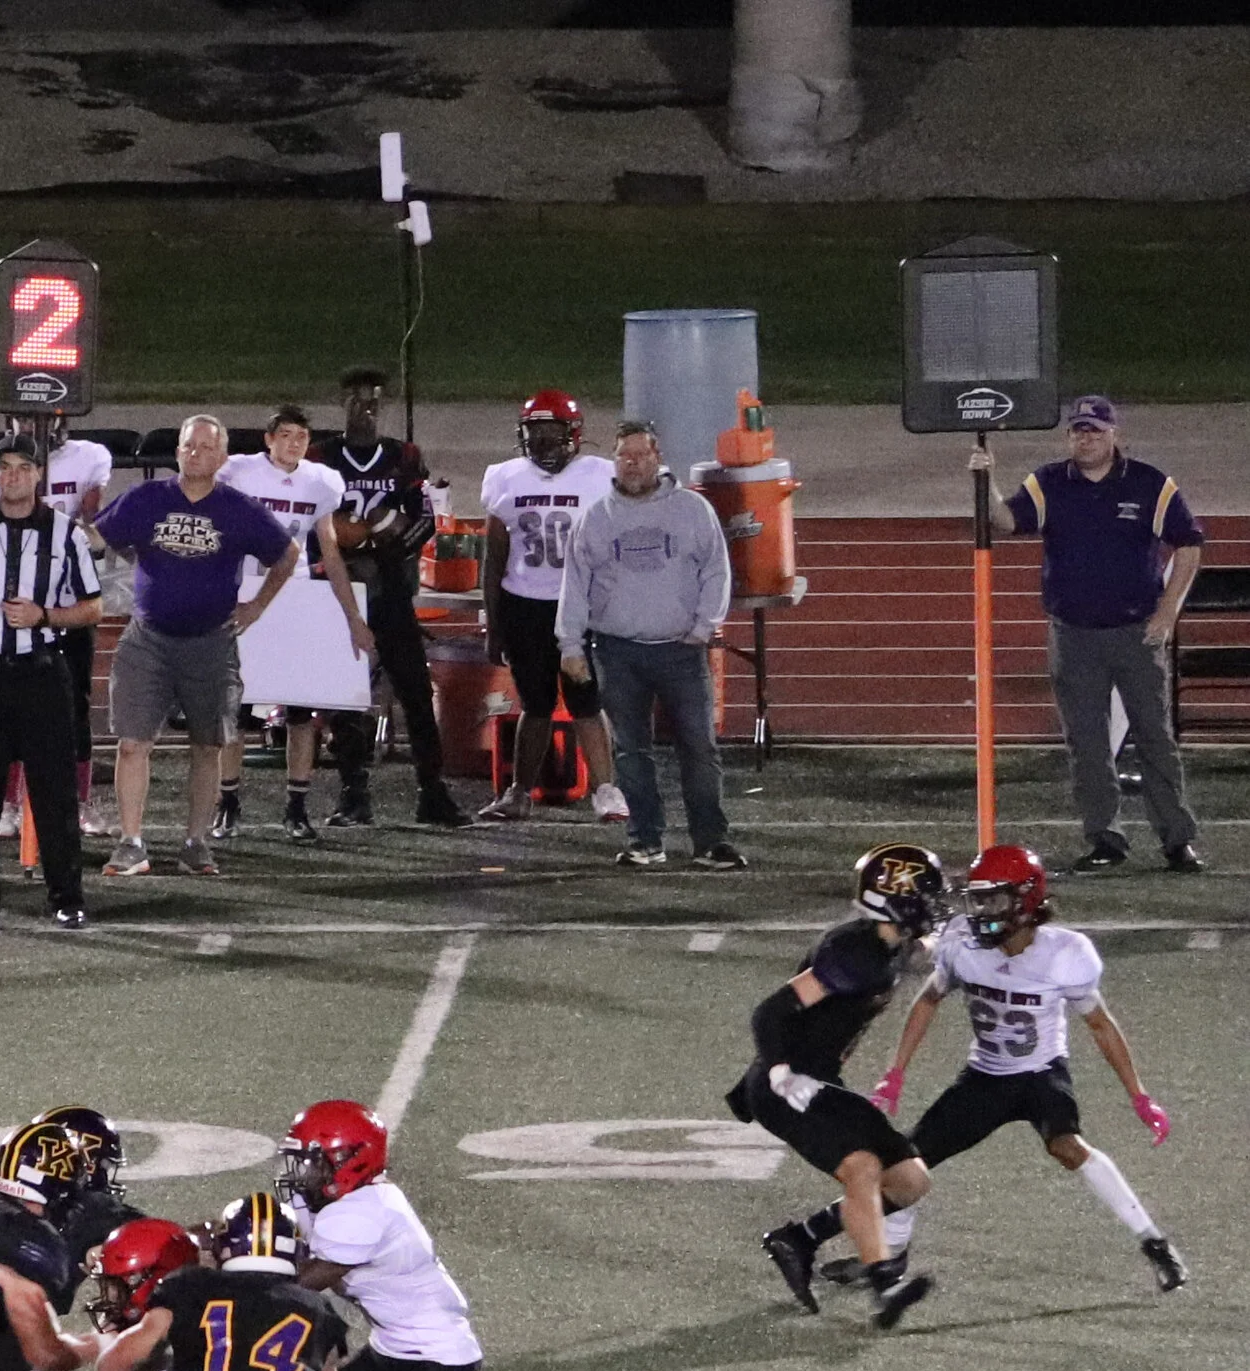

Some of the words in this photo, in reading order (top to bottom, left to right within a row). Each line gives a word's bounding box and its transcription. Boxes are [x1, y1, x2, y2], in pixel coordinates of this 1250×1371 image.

[8, 275, 84, 370] 2
[962, 410, 992, 420] DOWN
[347, 478, 396, 492] RDINALS
[168, 515, 212, 529] STATE
[155, 535, 180, 543] AND
[183, 536, 217, 551] FIELD
[156, 524, 219, 544] TRACK
[877, 858, 926, 897] K
[969, 1000, 1038, 1058] 23
[35, 1136, 79, 1180] K
